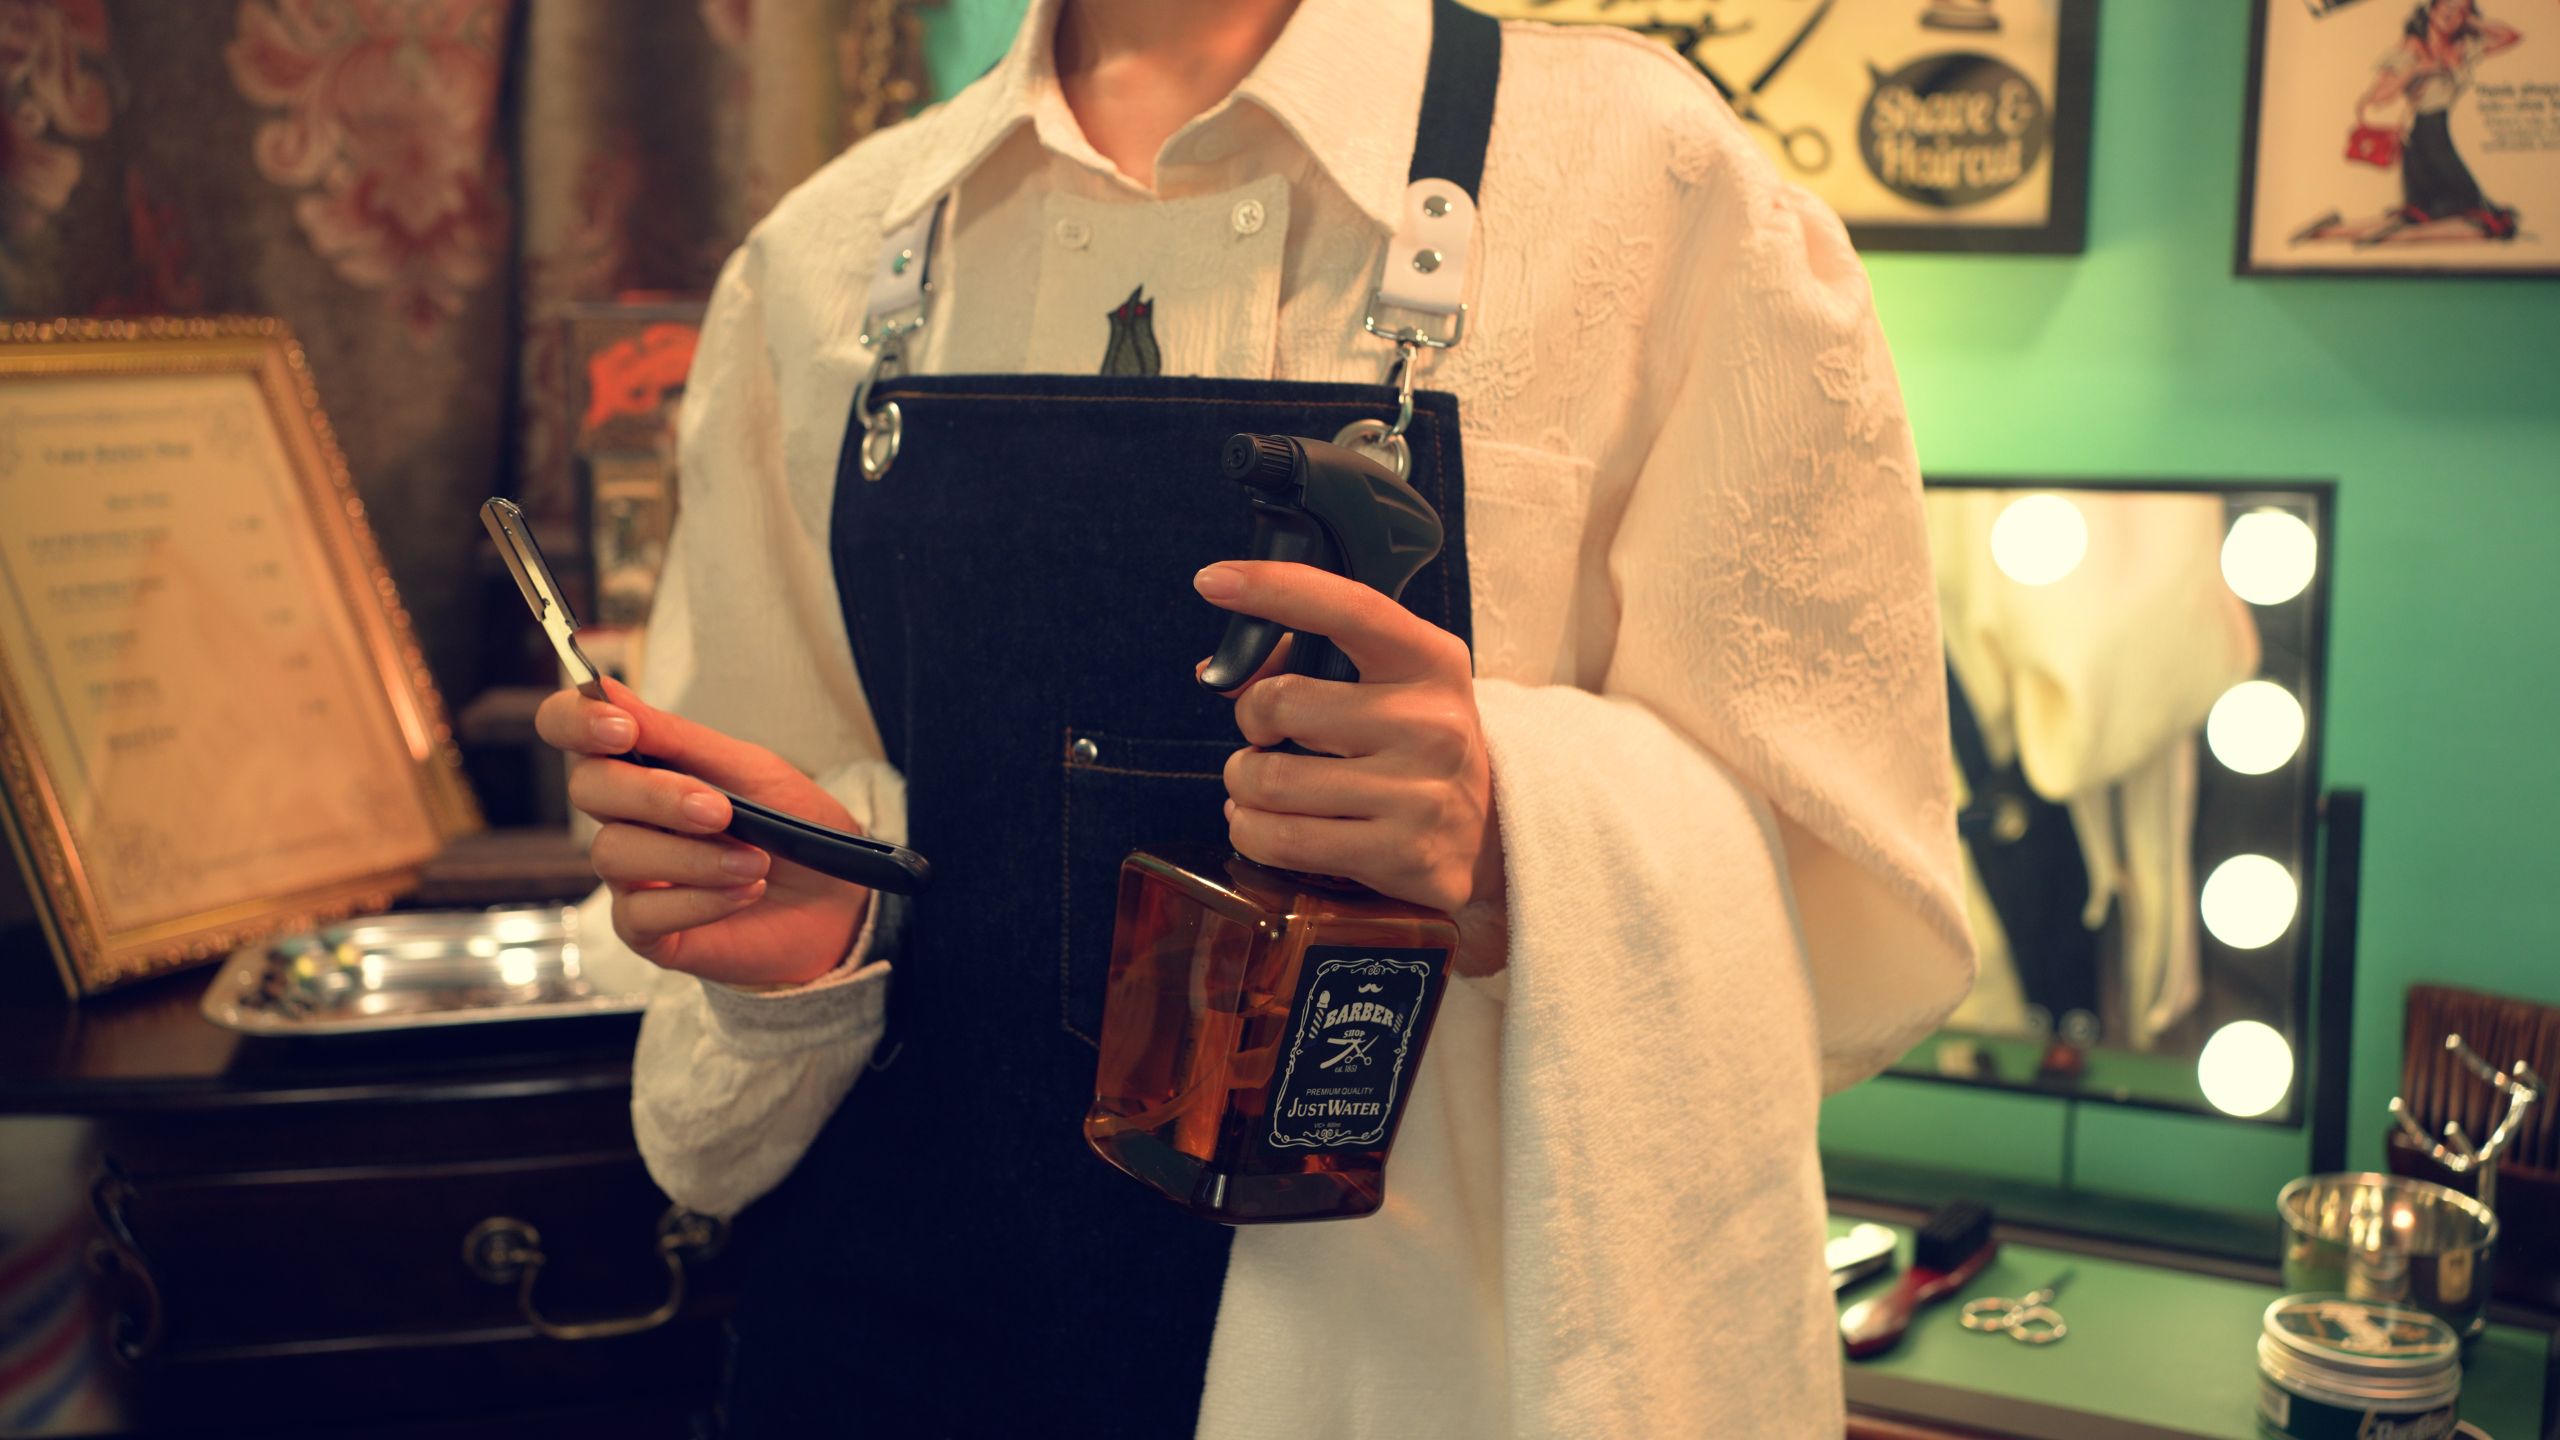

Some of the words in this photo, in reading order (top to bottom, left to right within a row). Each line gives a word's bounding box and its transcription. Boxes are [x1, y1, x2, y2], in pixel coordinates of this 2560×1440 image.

[1323, 1002, 1394, 1029] BARBER
[1343, 1029, 1366, 1038] SHOP
[1306, 1088, 1341, 1096] PREMIUM
[1341, 1087, 1374, 1095] QUALITY
